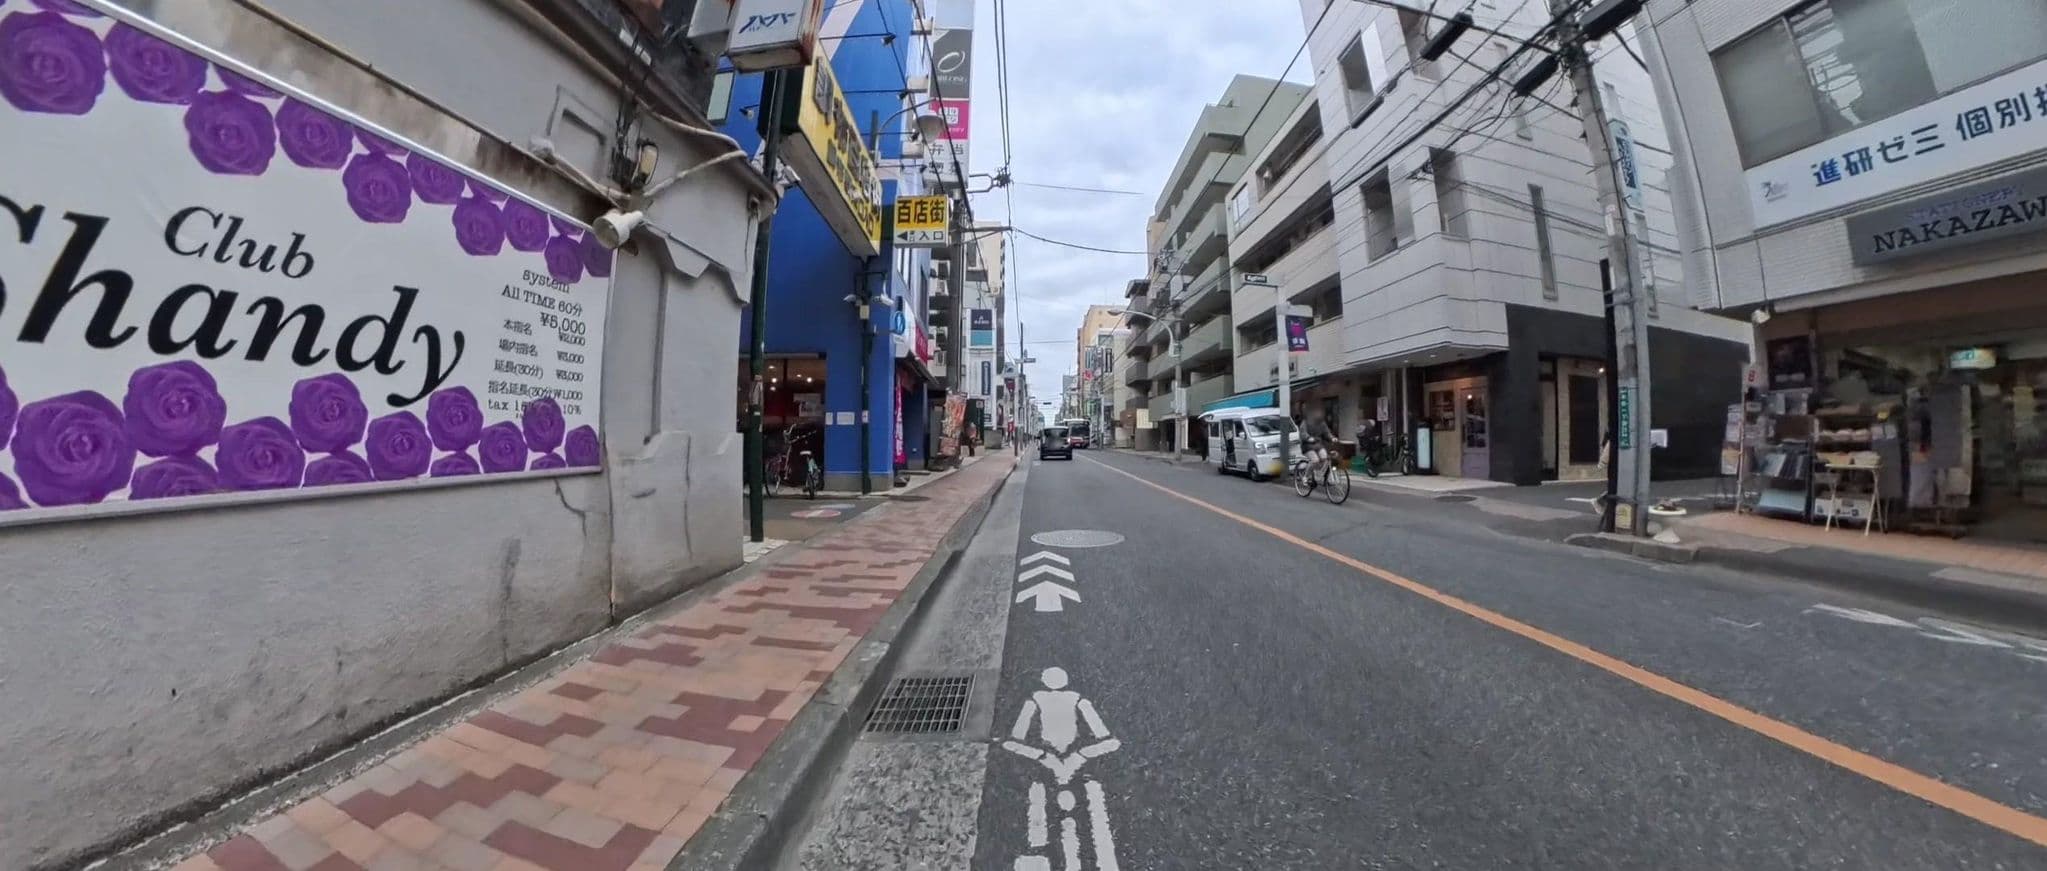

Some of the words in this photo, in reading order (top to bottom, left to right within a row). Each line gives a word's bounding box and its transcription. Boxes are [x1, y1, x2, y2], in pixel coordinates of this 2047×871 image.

[897, 199, 945, 224] 百店街
[164, 205, 315, 279] Club
[919, 231, 944, 241] 入口
[522, 269, 570, 294] system
[501, 284, 520, 300] All
[523, 290, 556, 310] TIME
[558, 300, 583, 317] 60分
[503, 319, 533, 336] 本指名
[540, 312, 586, 335] ¥5,000
[488, 399, 509, 411] tax
